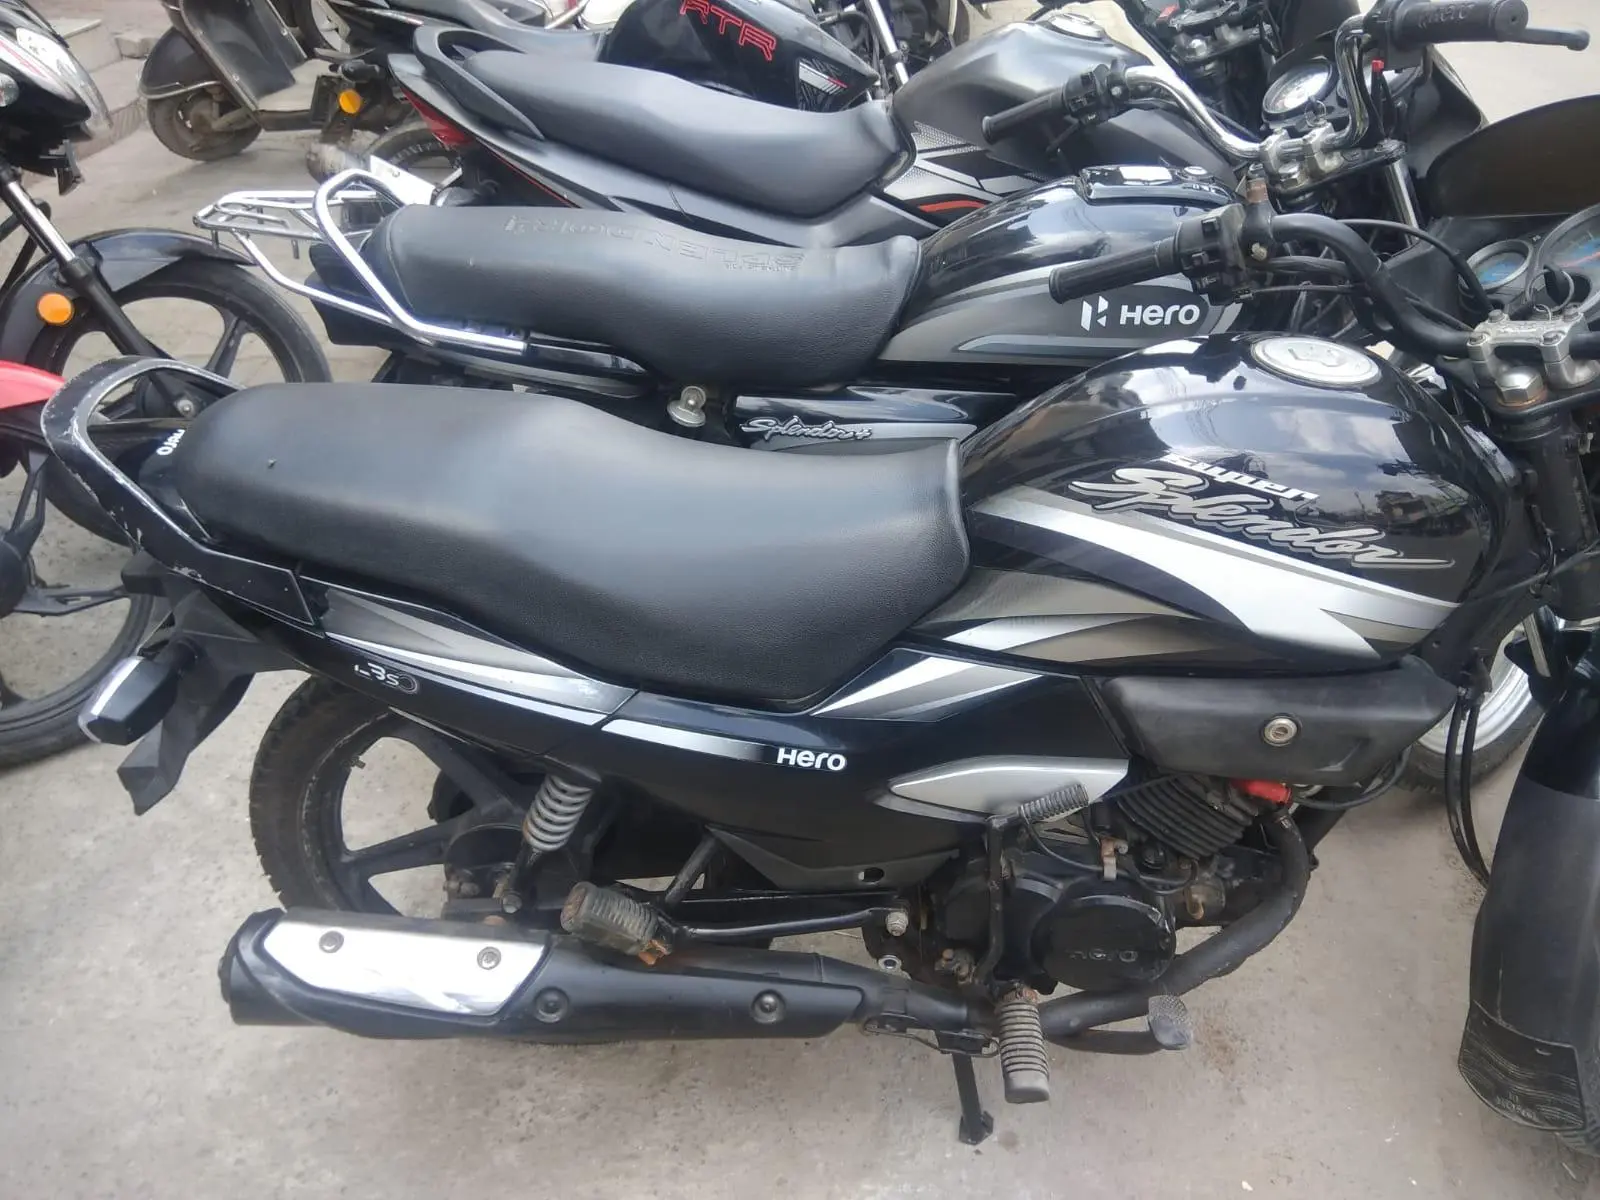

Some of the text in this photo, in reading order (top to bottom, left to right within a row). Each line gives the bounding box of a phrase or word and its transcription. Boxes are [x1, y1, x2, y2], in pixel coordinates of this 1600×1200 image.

[680, 0, 777, 61] RTR
[1119, 304, 1200, 325] Hero
[1067, 468, 1455, 568] Splendor
[777, 747, 846, 771] Hero
